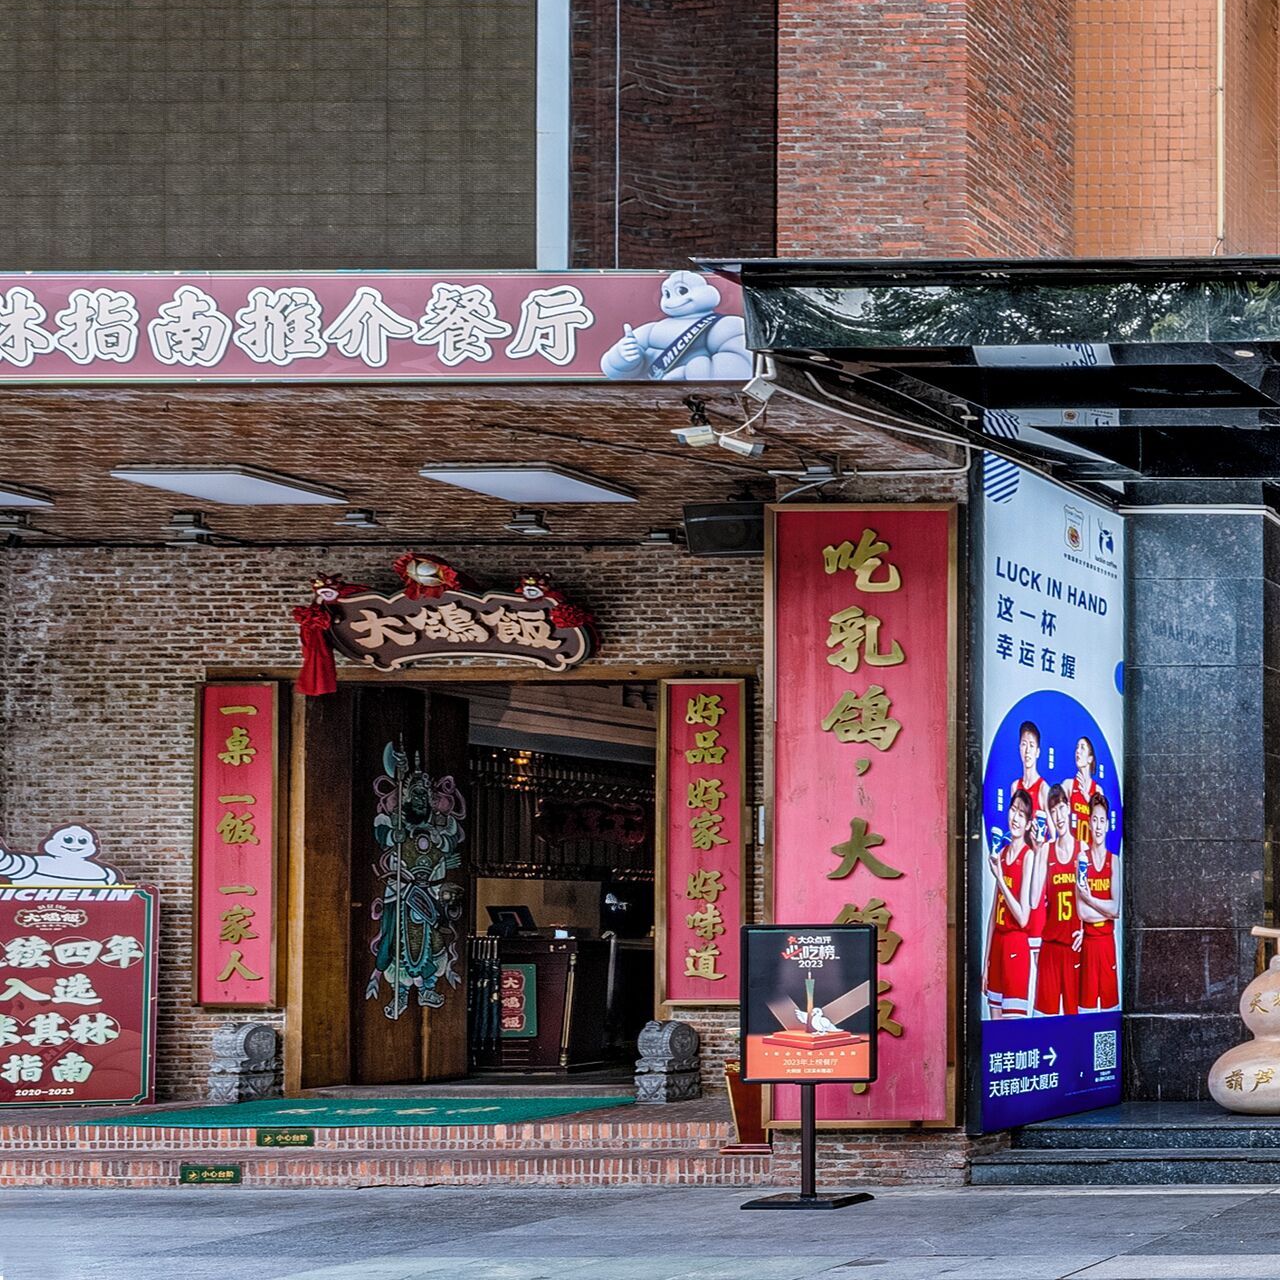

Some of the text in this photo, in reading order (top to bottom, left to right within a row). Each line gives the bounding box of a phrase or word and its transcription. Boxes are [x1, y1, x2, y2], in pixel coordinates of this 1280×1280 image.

[996, 556, 1108, 616] LUCK IN HAND
[997, 593, 1057, 637] 这一杯
[996, 633, 1076, 679] 幸运在握
[1074, 803, 1090, 814] CHIN
[1053, 873, 1076, 885] CHINA
[1057, 891, 1073, 922] 15
[0, 935, 145, 969] 续四年
[781, 945, 836, 961] 必吃榜
[797, 936, 832, 945] 大众点评
[798, 960, 824, 968] 2023
[0, 973, 102, 1005] 入选
[0, 1052, 94, 1084] 指南
[989, 1048, 1040, 1074] 瑞幸咖啡
[989, 1072, 1059, 1098] 天辉商业大厦店
[275, 1133, 309, 1142] 小心台阶
[201, 1169, 235, 1179] 小心台阶
